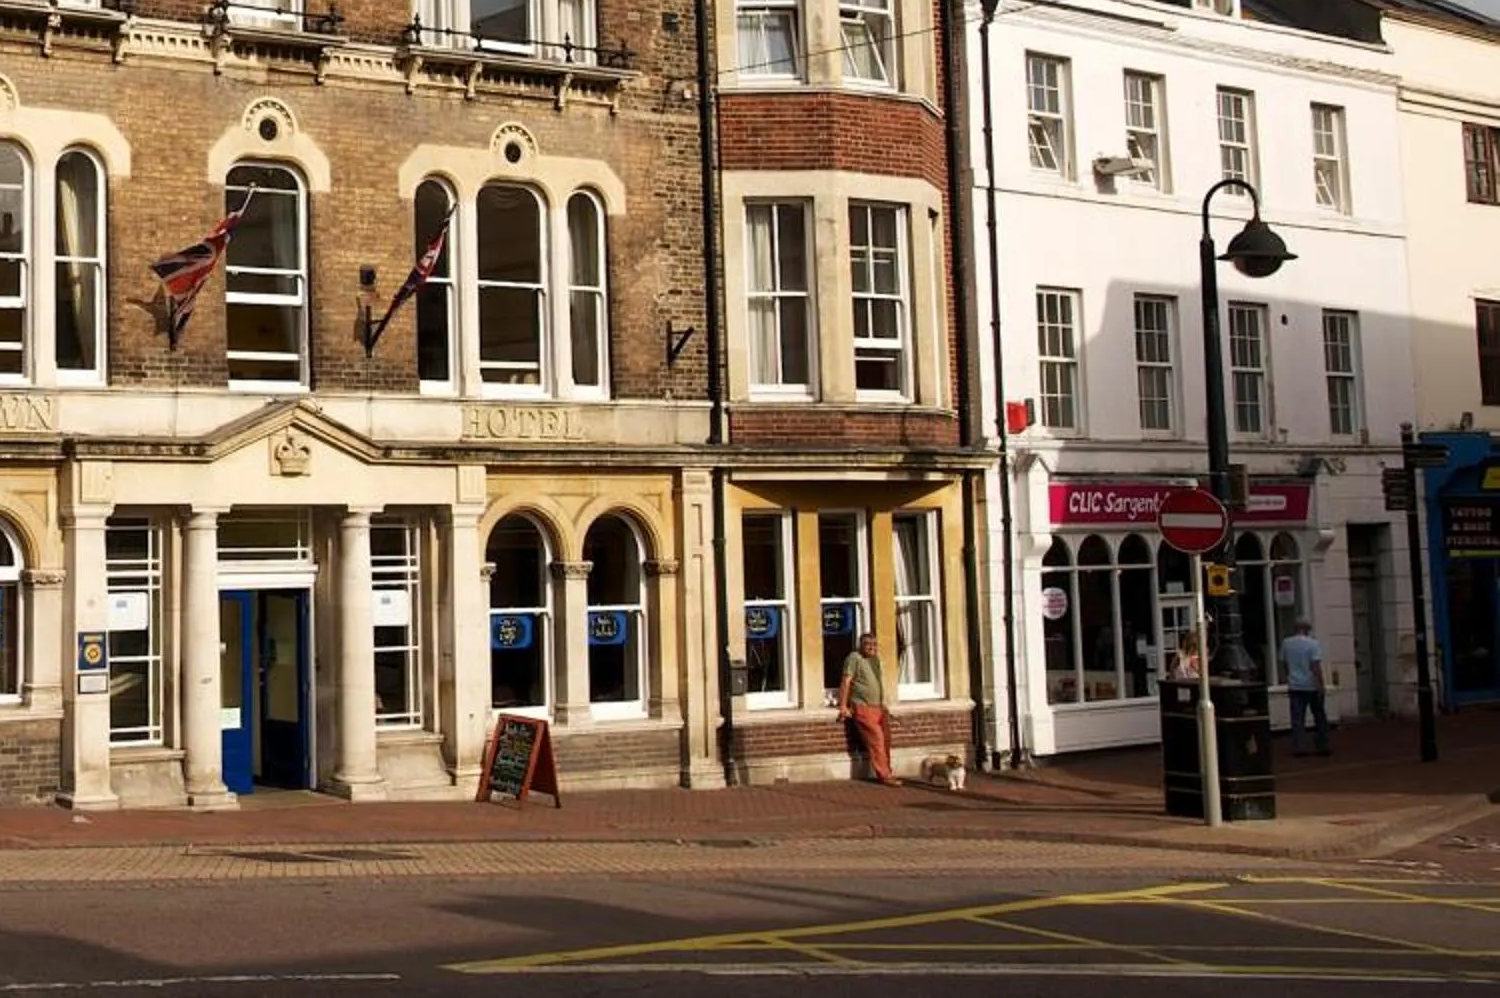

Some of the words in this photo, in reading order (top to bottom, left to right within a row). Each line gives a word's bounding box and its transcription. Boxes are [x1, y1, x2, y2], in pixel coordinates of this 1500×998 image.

[460, 405, 583, 440] HOTEL
[1069, 491, 1103, 514] CLIC
[1104, 491, 1161, 521] Sargent
